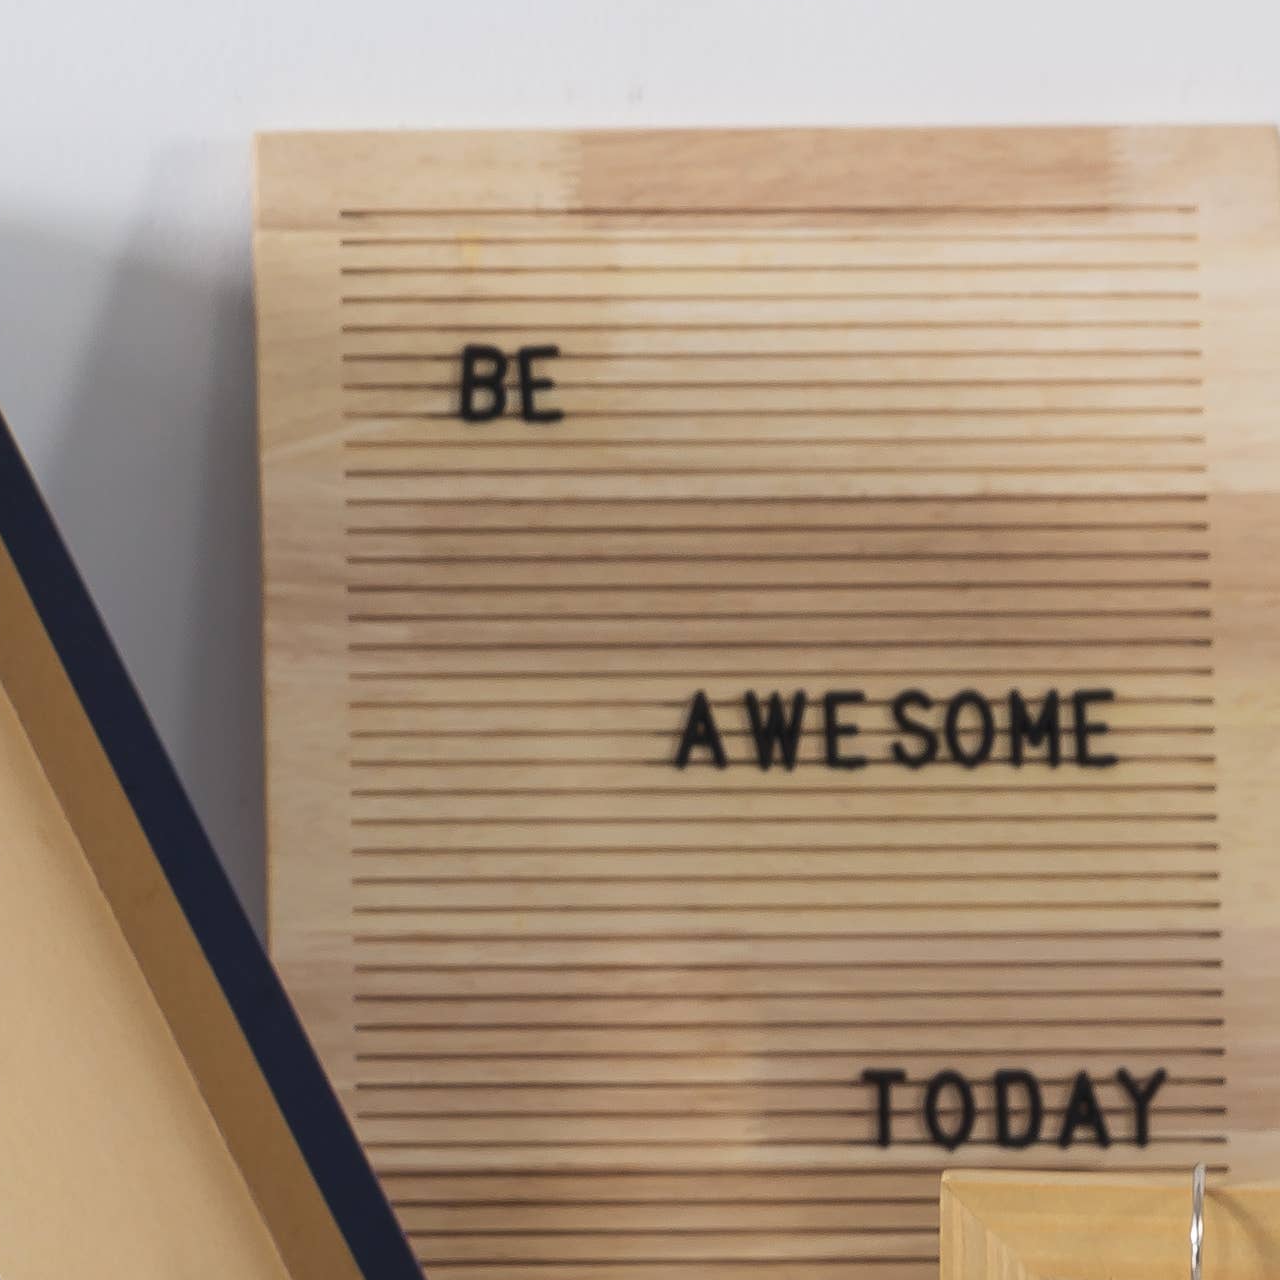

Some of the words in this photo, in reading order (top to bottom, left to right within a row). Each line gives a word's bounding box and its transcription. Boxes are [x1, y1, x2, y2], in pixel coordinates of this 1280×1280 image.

[458, 344, 564, 423] BE
[673, 689, 1119, 772] AWESOME
[861, 1068, 1168, 1151] TODAY
